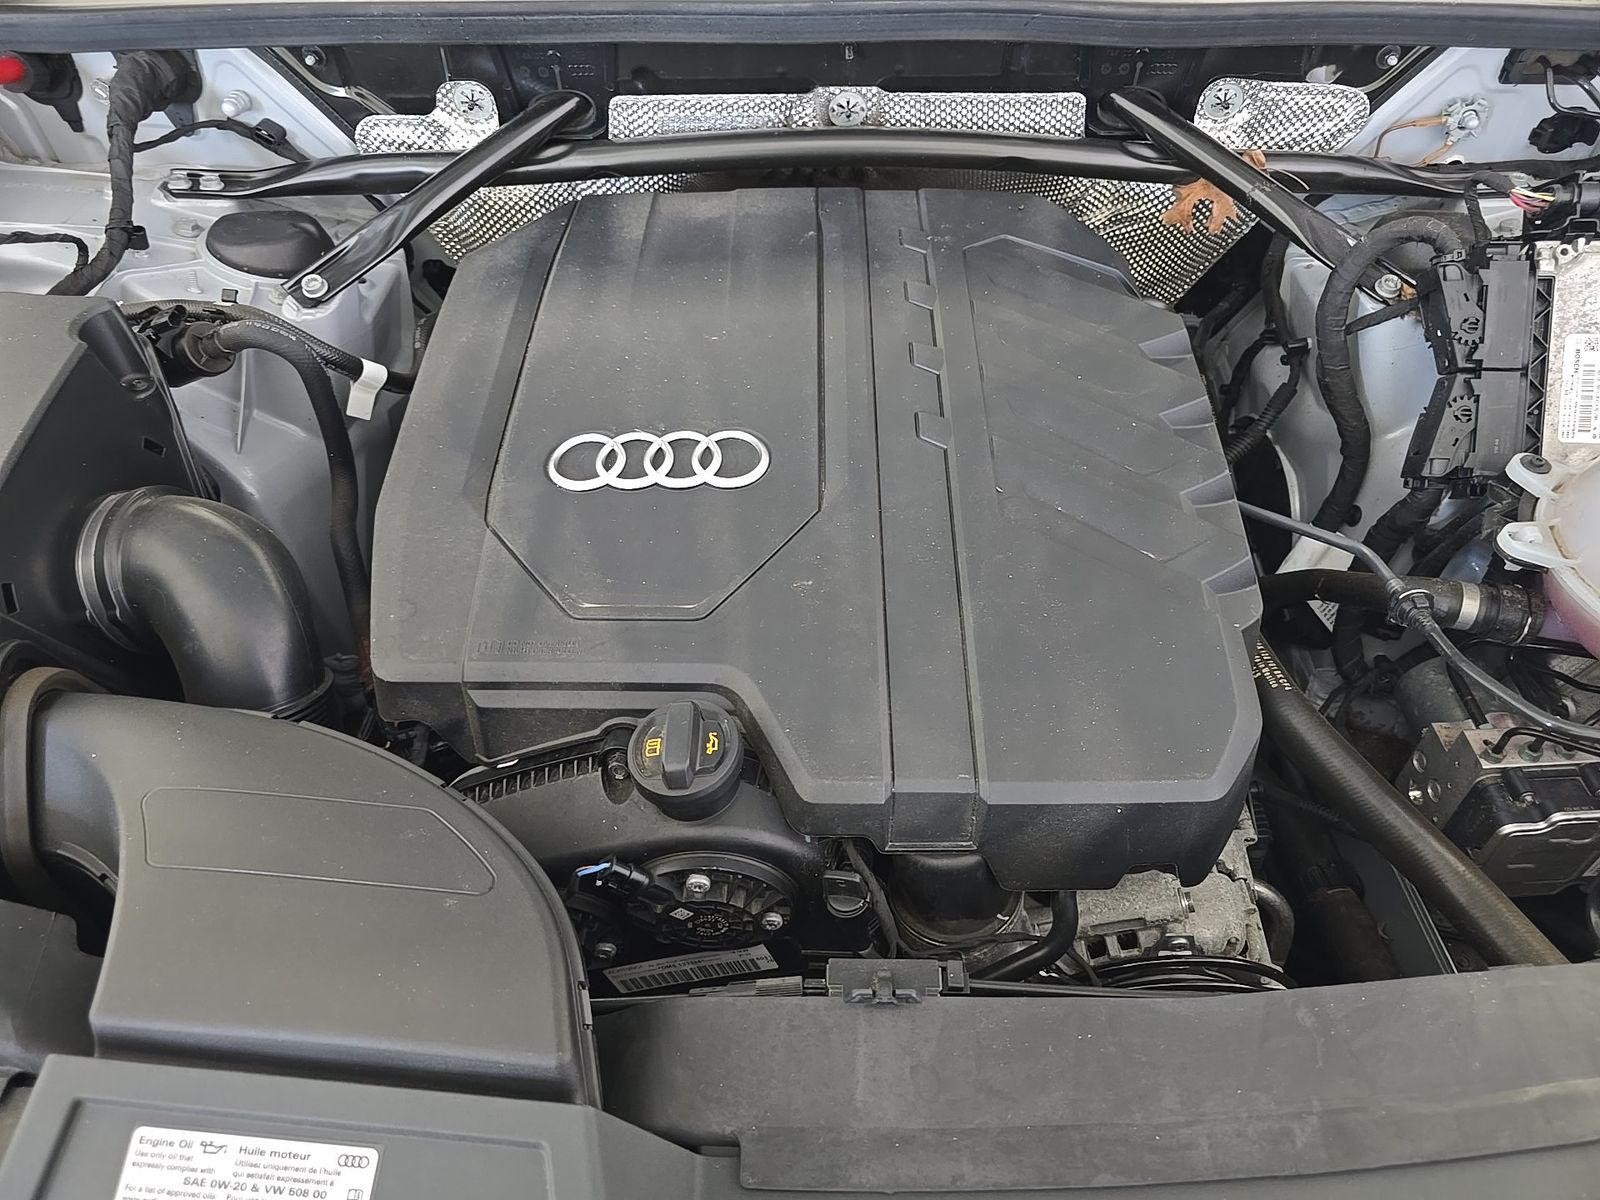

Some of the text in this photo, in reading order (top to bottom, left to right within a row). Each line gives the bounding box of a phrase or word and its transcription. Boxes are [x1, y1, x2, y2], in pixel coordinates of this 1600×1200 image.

[138, 1135, 194, 1149] Engine Oil
[134, 1149, 194, 1162] Use only oil that
[238, 1145, 312, 1161] Huile moteur
[132, 1161, 216, 1175] expressly complies with
[232, 1171, 245, 1179] qui
[262, 1163, 307, 1174] uniquement
[308, 1166, 318, 1174] de
[124, 1183, 137, 1192] For
[166, 1189, 201, 1199] approved
[183, 1176, 207, 1188] SAE
[210, 1179, 248, 1192] 0W-20
[250, 1183, 260, 1193] &
[264, 1184, 286, 1196] VW
[312, 1189, 328, 1200] 00
